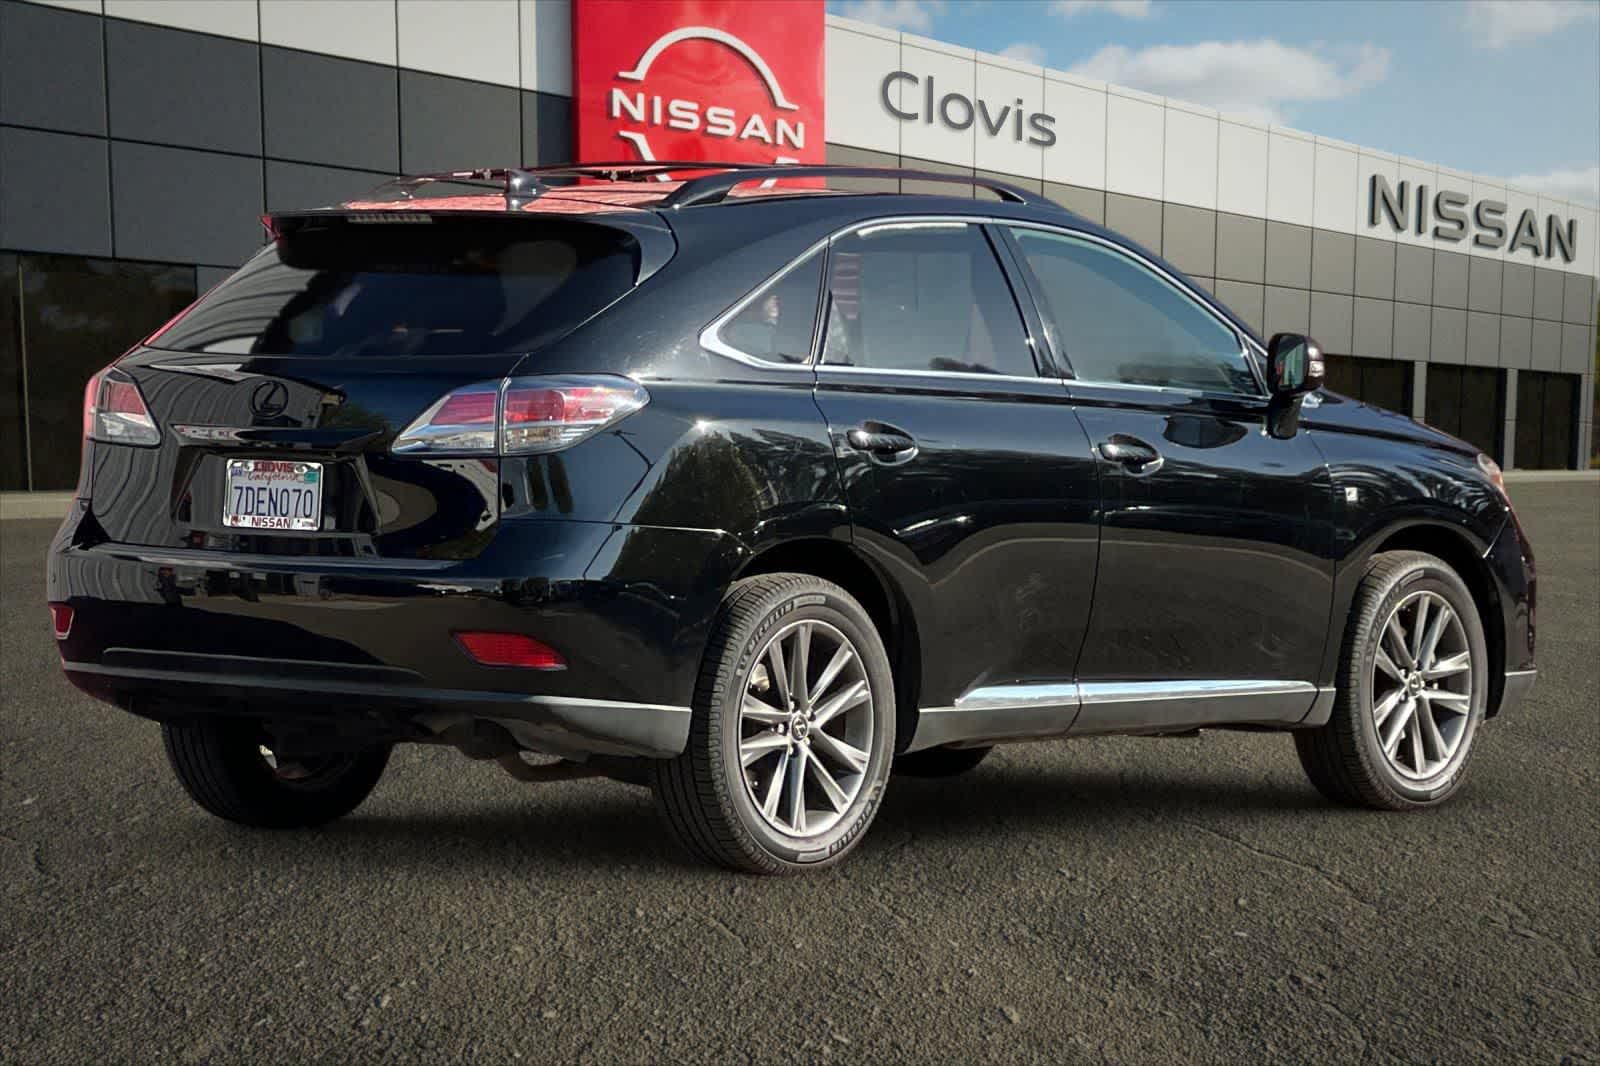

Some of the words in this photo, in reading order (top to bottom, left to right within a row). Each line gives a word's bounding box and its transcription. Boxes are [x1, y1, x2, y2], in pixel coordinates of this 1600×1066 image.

[611, 88, 806, 149] NISSAN
[880, 70, 1058, 148] Clovis
[1368, 174, 1578, 264] NISSAN
[233, 486, 314, 519] 7DEN070
[251, 516, 291, 528] NISSAN
